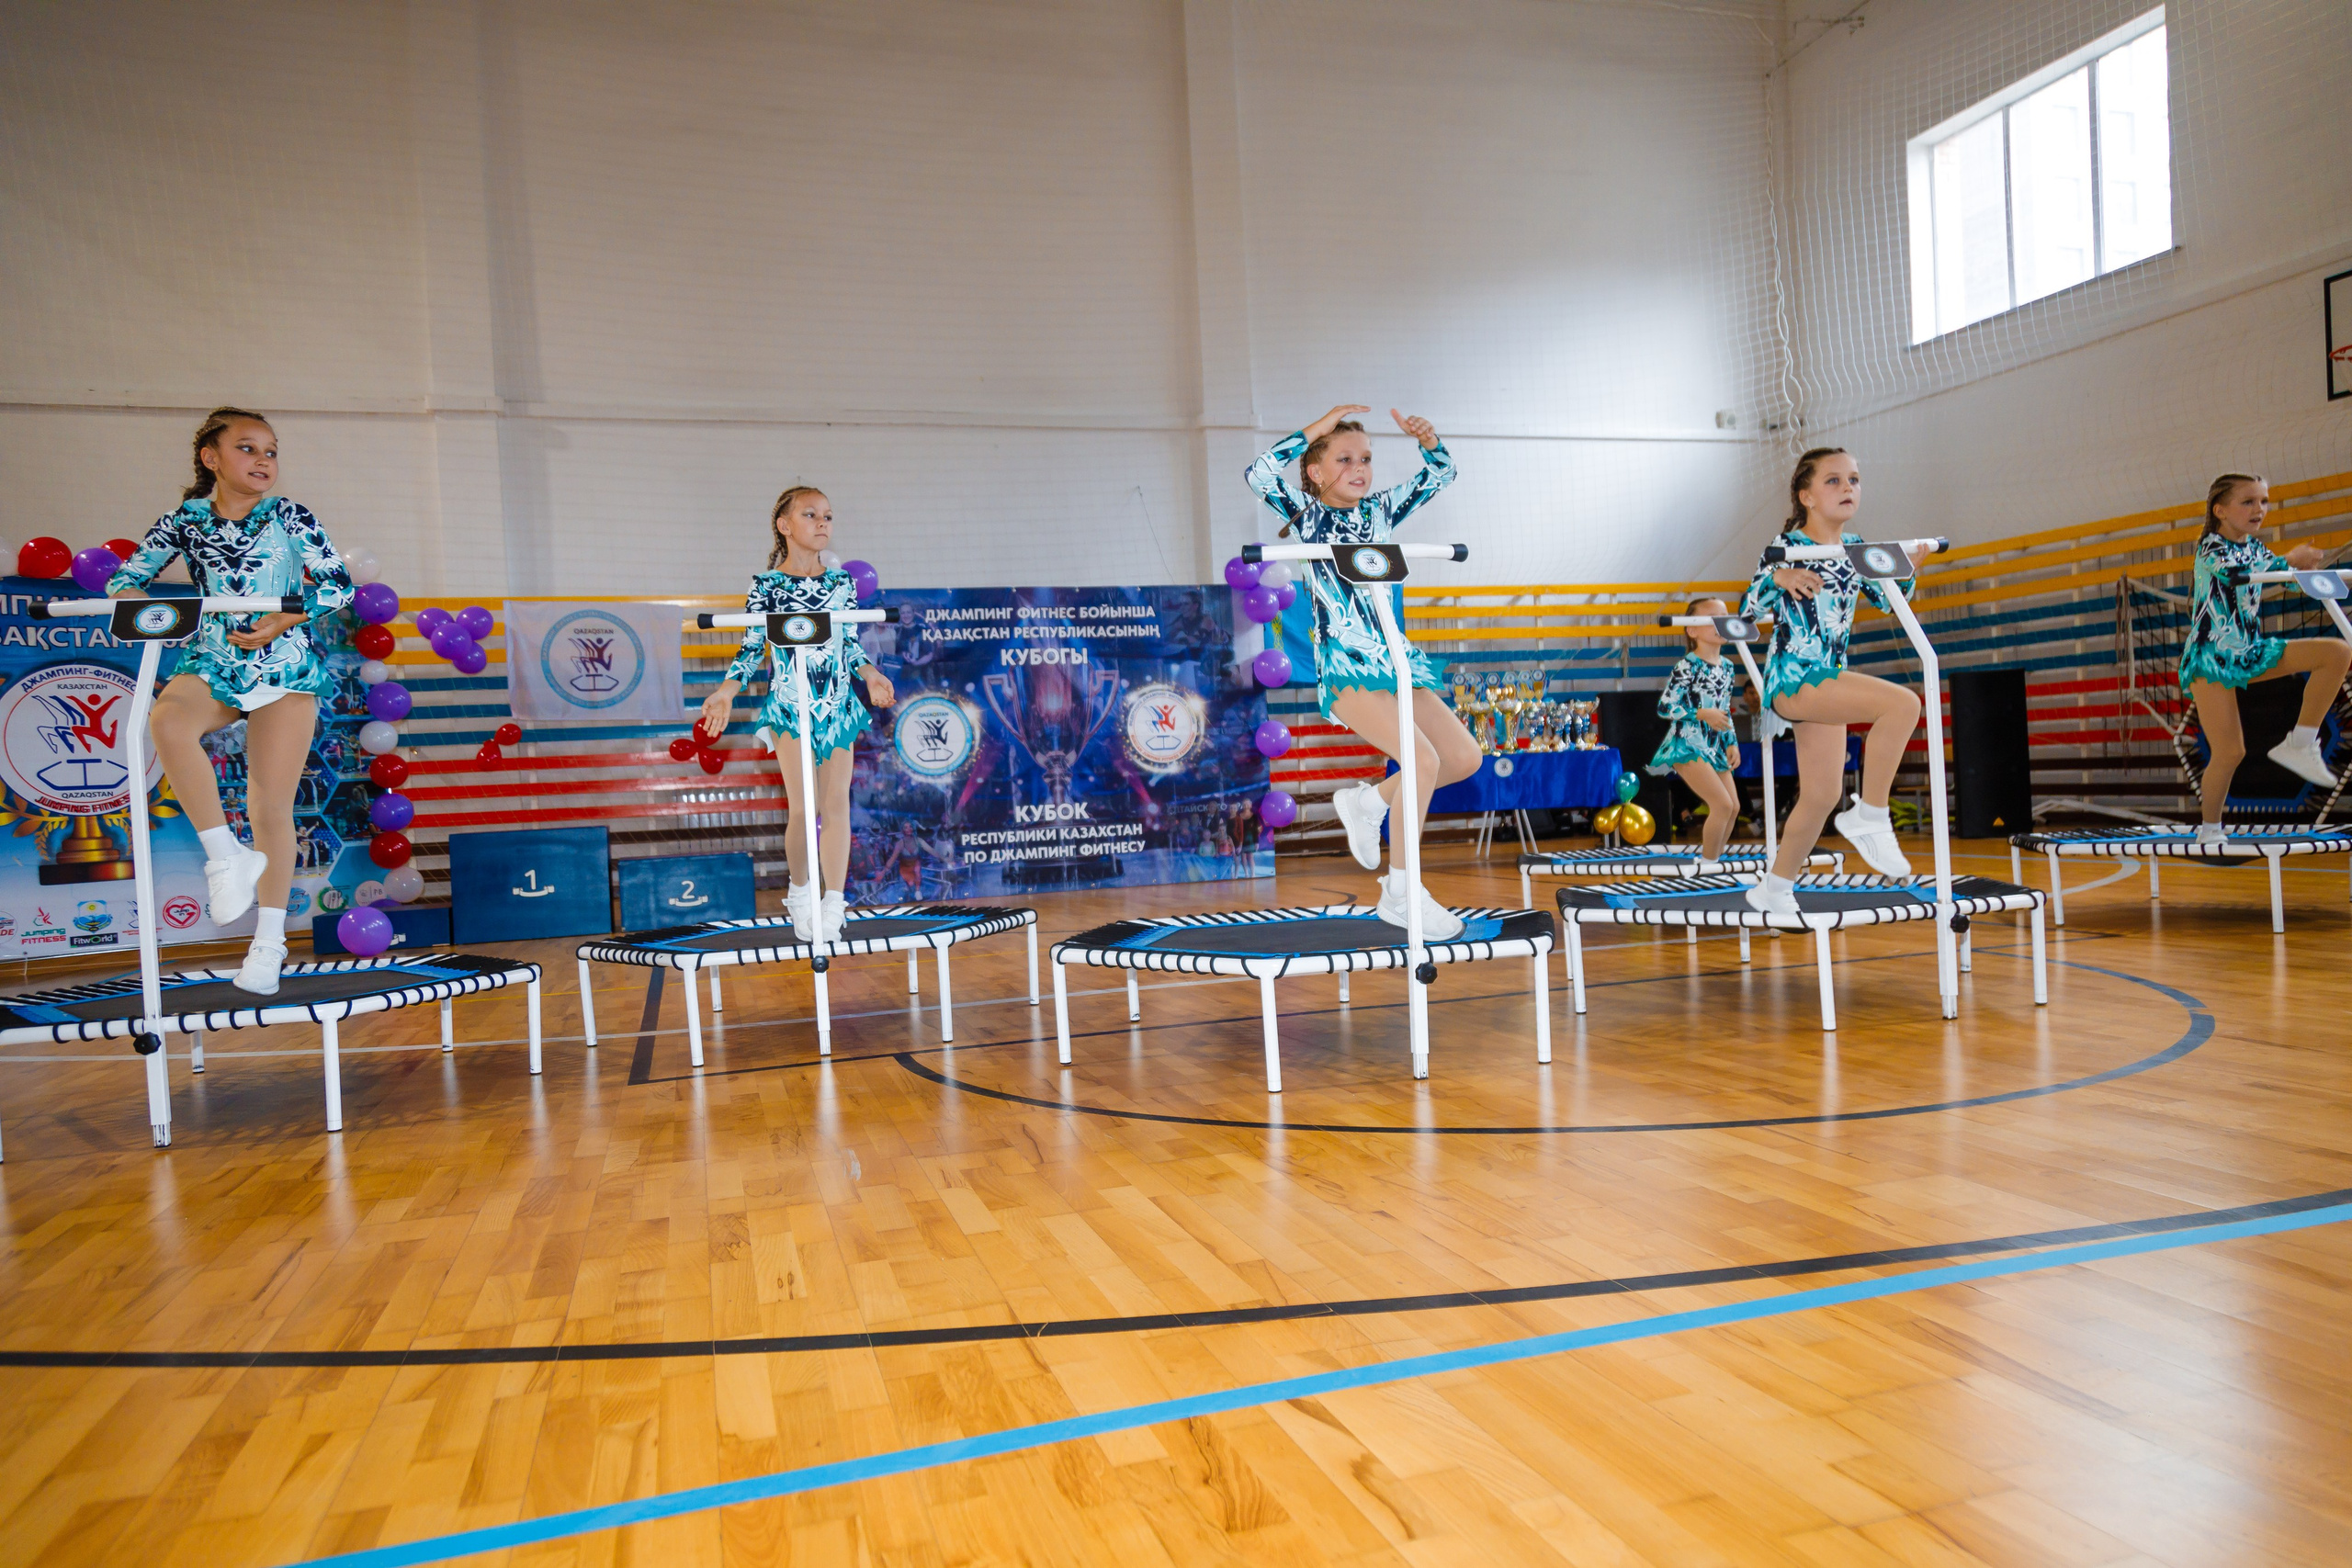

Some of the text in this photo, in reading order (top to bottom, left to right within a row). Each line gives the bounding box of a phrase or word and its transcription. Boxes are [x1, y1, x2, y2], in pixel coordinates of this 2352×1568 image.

[925, 604, 1156, 623] ДЖАМПИНГ ФИТНЕС БОЙЫНША
[0, 626, 132, 650] АҚСТА
[922, 625, 1160, 643] ҚАЗАҚСТАН РЕСПУБЛИКАСЫНЫҢ
[1001, 648, 1088, 666] КУБОГЫ
[35, 794, 130, 813] JUMPING FITNES
[62, 791, 114, 799] QAZAQSTAN
[1015, 802, 1090, 823] КУБОК
[961, 823, 1143, 846] РЕСПУБЛИКИ КАЗАХСТАН
[965, 840, 1146, 863] ПО ДЖАМПИНГ ФИТНЕСУ
[525, 869, 537, 890] 1
[681, 880, 695, 899] 2
